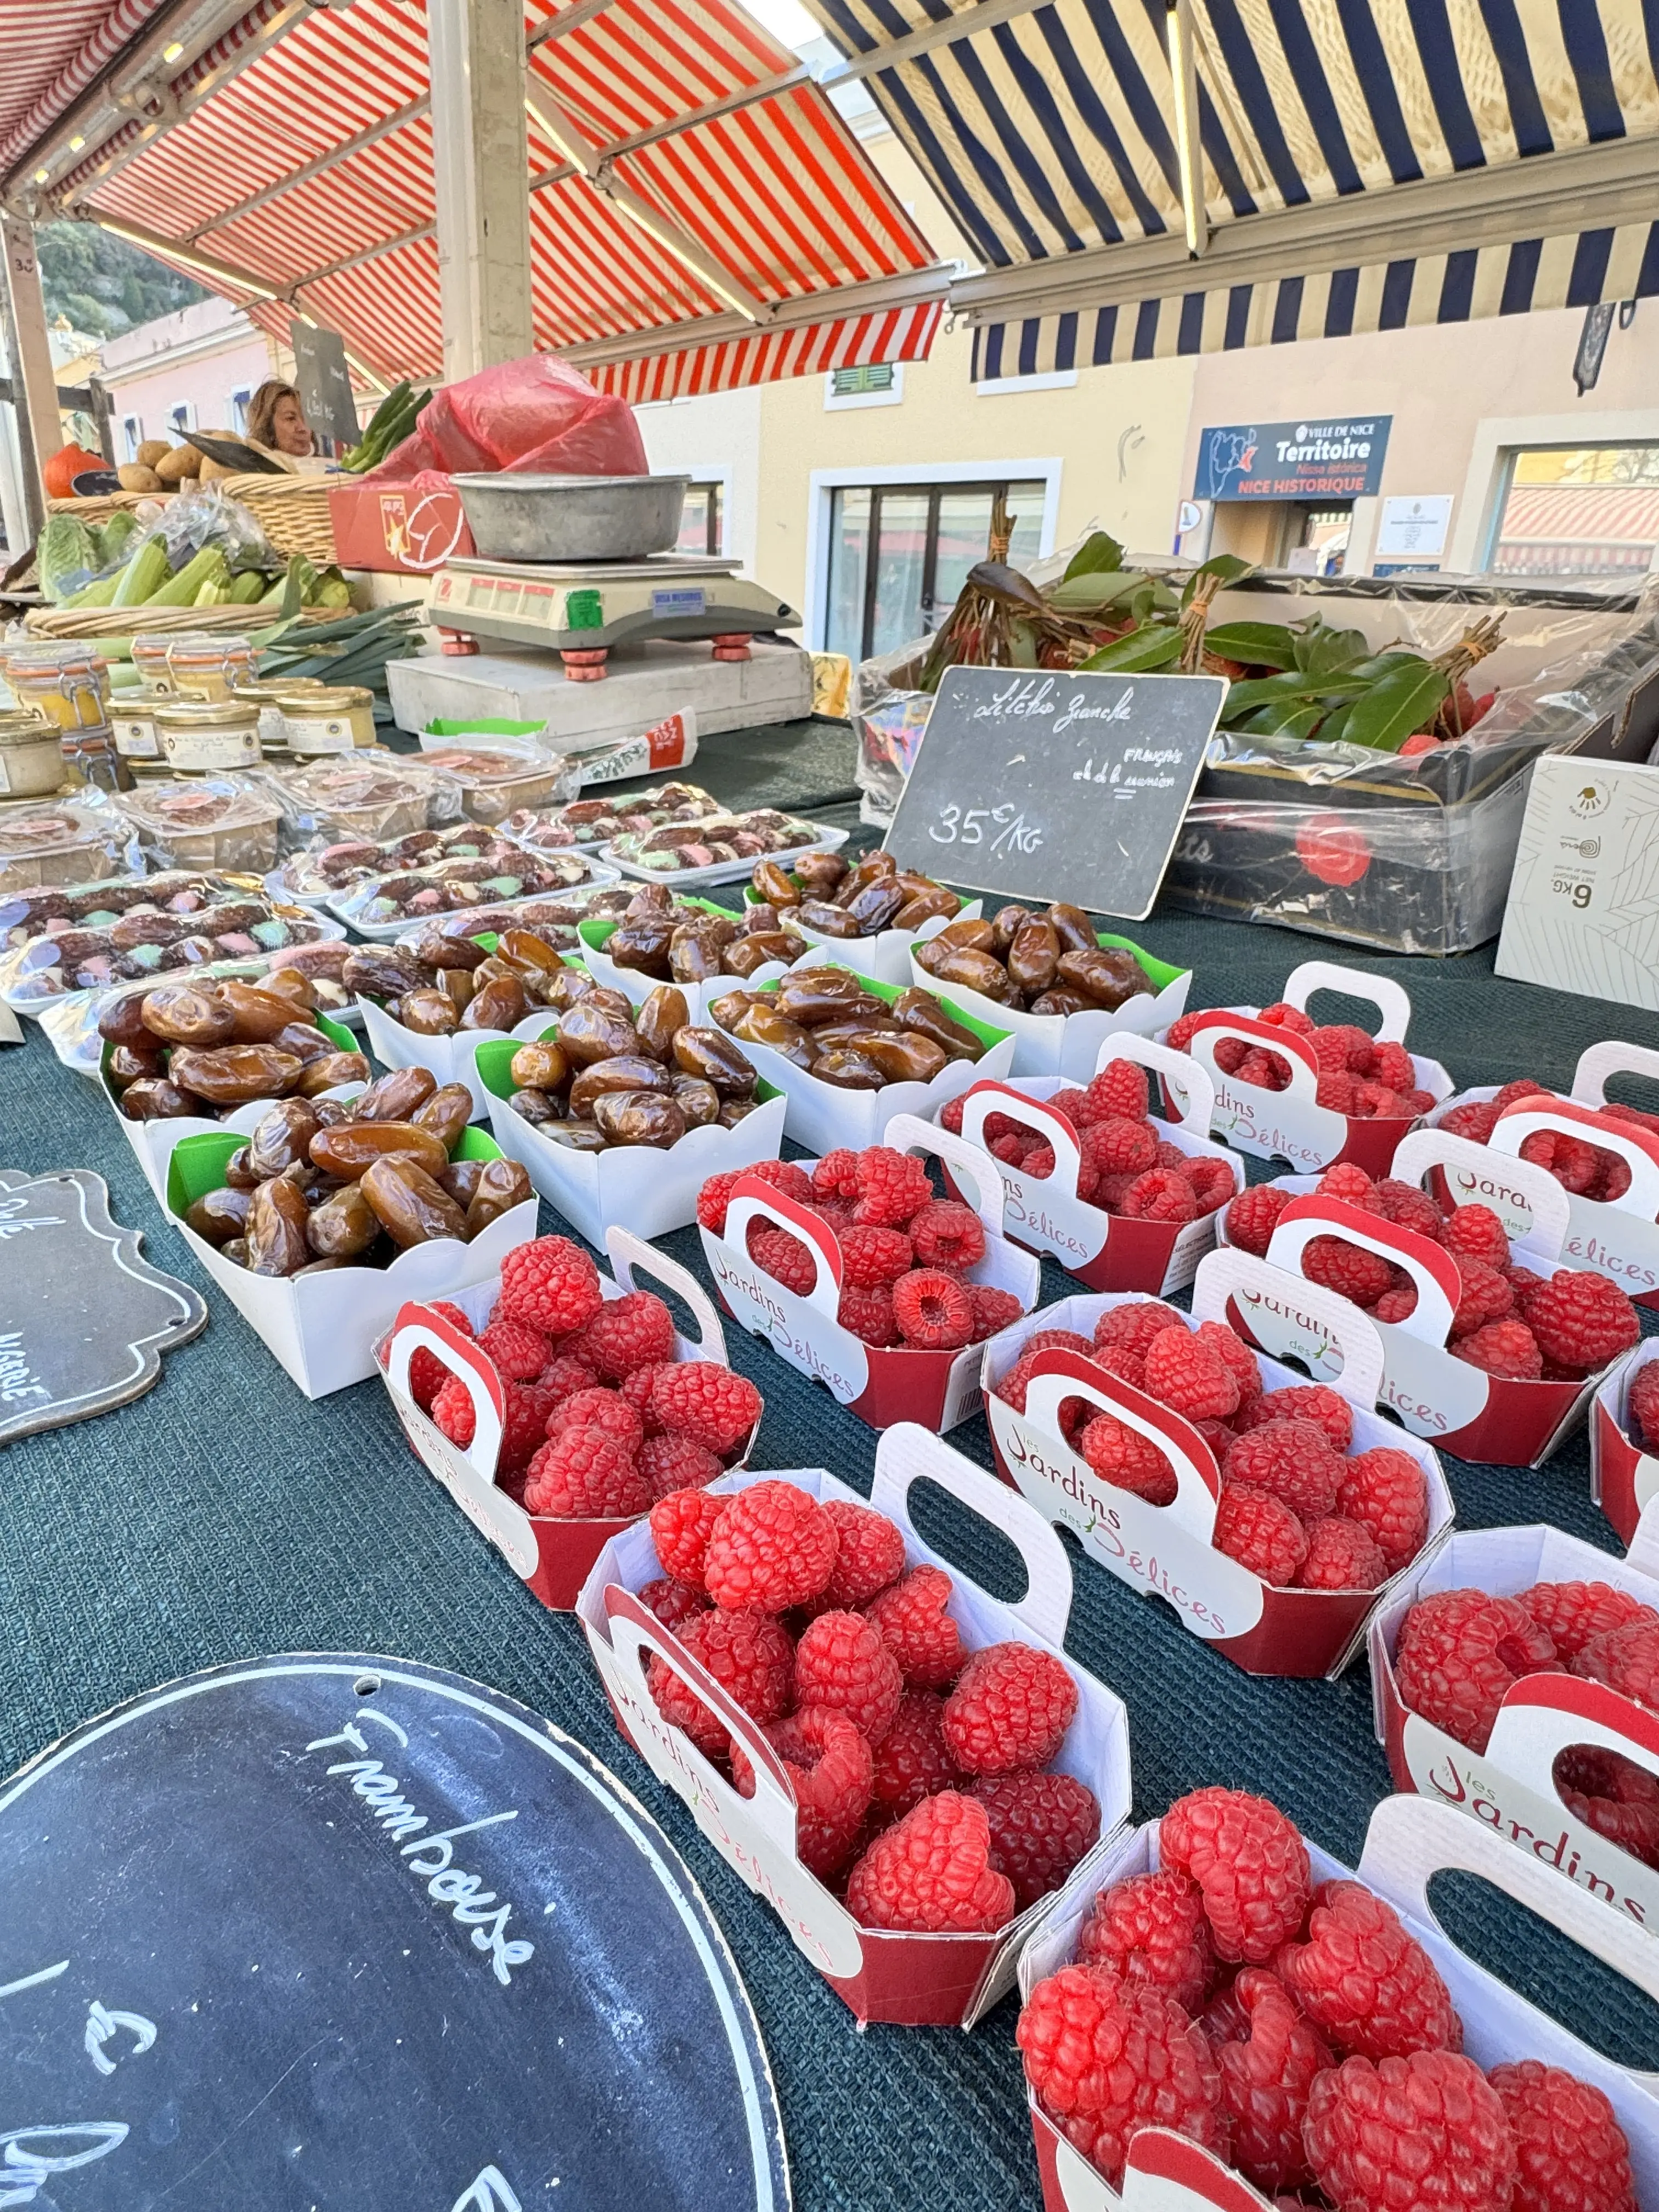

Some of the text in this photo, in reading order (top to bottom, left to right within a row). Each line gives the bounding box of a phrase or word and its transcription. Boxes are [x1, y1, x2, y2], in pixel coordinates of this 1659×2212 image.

[1276, 437, 1371, 462] Territoire
[1308, 424, 1375, 438] VILLE DE NICE
[1238, 477, 1365, 494] NICE HISTORIQUE
[1234, 1117, 1323, 1166] Délices
[1005, 1196, 1088, 1259] Délices
[713, 1247, 787, 1323] Jardins
[1564, 1236, 1656, 1286] élices
[772, 1319, 855, 1398] Délices
[1289, 1339, 1311, 1357] des
[1022, 1432, 1040, 1453] les
[1006, 1423, 1121, 1530] Jardins
[1059, 1507, 1082, 1530] des
[1093, 1522, 1227, 1635] Délices
[607, 1659, 720, 1813] Jardins
[1465, 1770, 1497, 1801] les
[1429, 1755, 1646, 1923] Jardins
